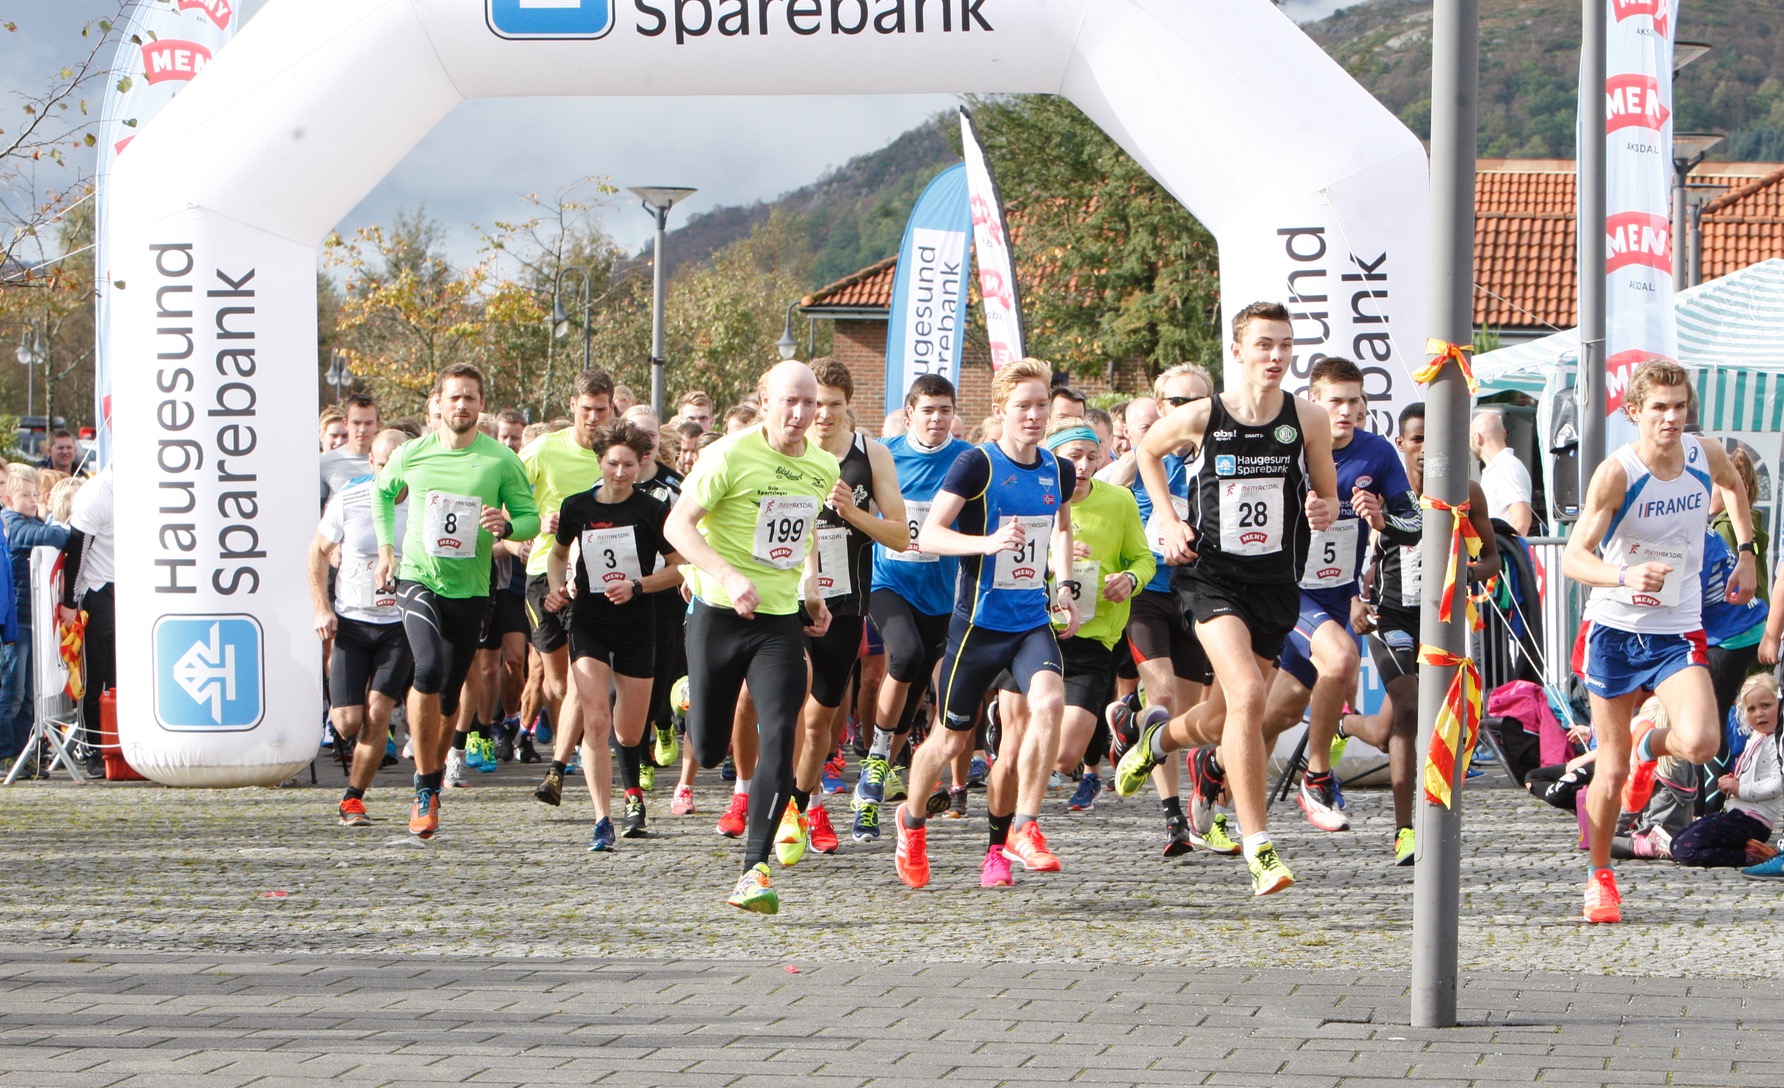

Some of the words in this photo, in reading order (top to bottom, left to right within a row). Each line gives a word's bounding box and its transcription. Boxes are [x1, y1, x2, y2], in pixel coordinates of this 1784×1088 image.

[636, 0, 994, 45] Sparebank
[1627, 142, 1659, 154] AKSDAL
[1606, 223, 1671, 260] MEN
[1629, 280, 1655, 291] AKSDAL
[149, 243, 204, 593] Haugesund
[206, 267, 267, 595] Sparebank
[1237, 465, 1289, 476] Sparebank
[444, 513, 457, 535] 8
[1239, 501, 1268, 528] 28
[767, 518, 804, 543] 199
[1243, 533, 1266, 541] MENY
[439, 540, 460, 548] MENY
[772, 549, 792, 557] MENY
[1013, 538, 1035, 563] 31
[1323, 542, 1336, 564] 5
[603, 548, 617, 569] 3
[605, 573, 624, 581] MENY
[1319, 569, 1340, 577] MENY
[1634, 595, 1660, 606] MENY
